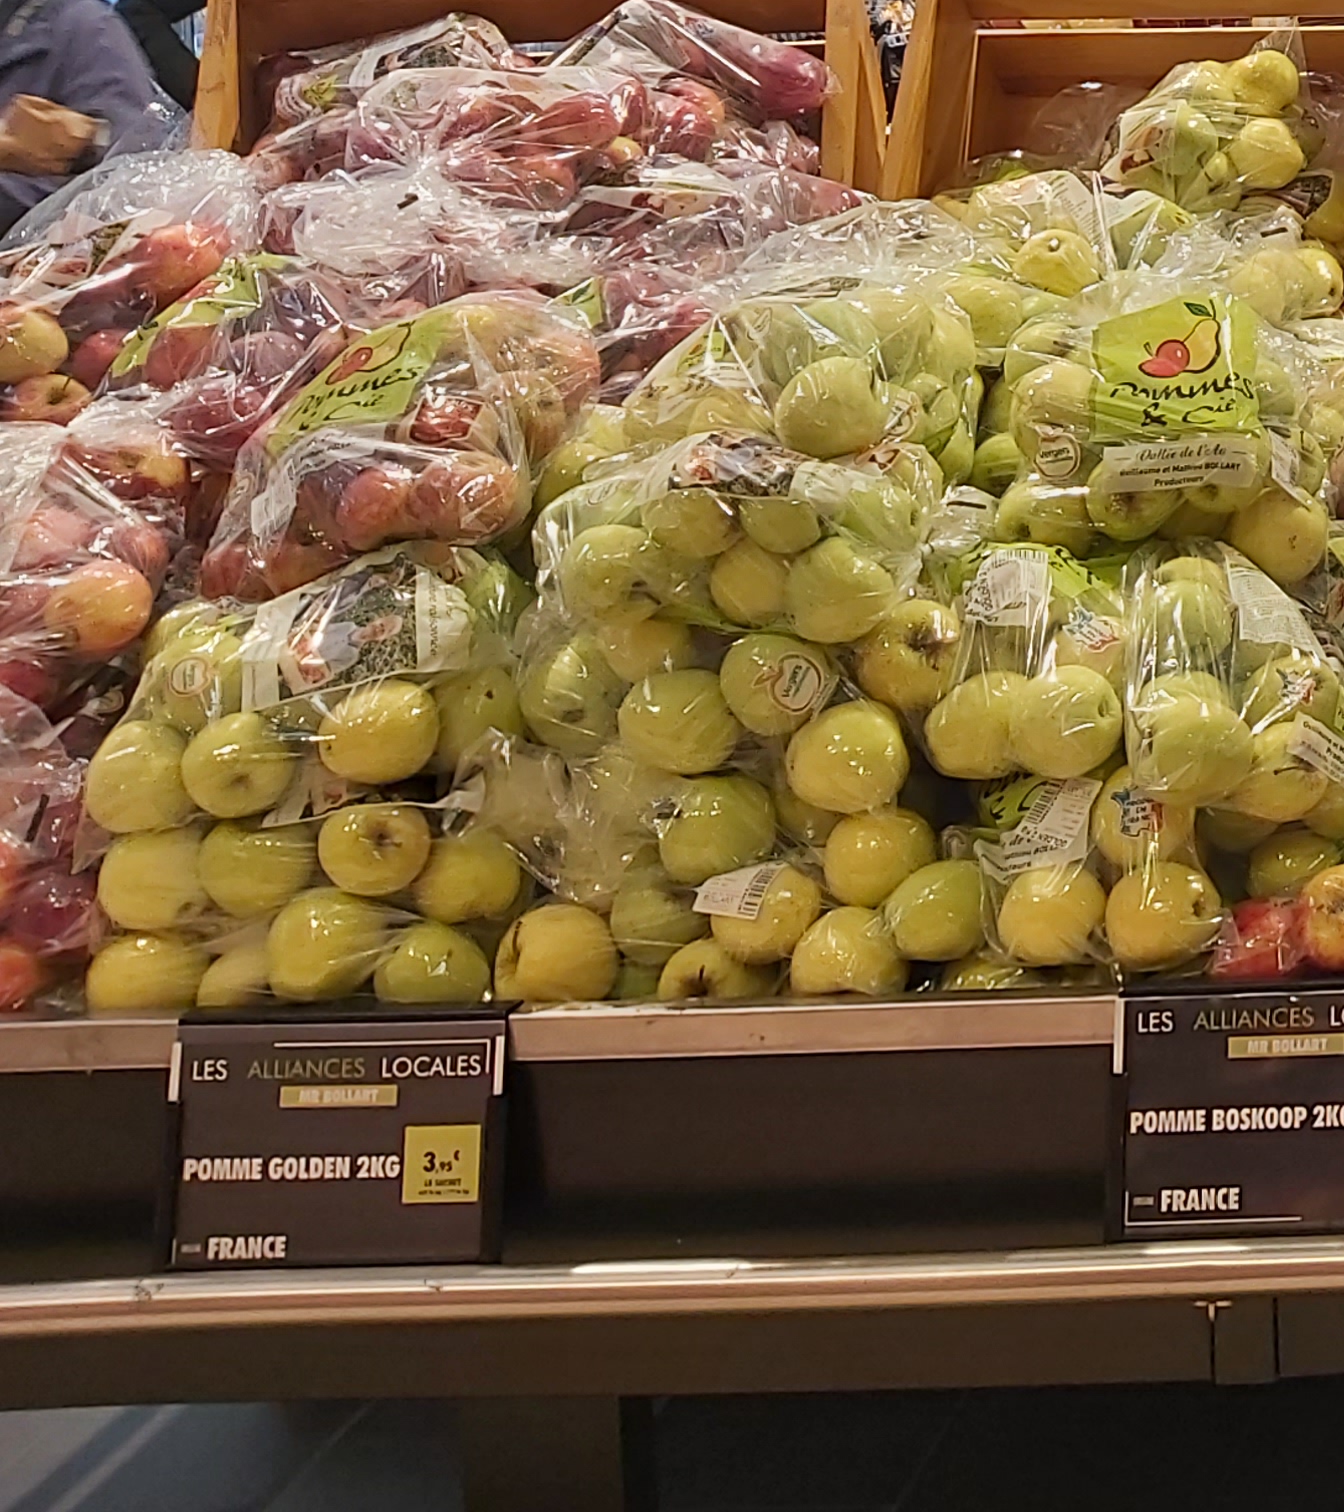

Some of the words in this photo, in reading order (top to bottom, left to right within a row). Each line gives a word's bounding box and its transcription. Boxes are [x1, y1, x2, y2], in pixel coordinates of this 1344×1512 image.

[1137, 1010, 1174, 1033] LES
[1193, 1007, 1315, 1031] ALLIANCES
[1271, 1037, 1329, 1053] BOLLART
[192, 1058, 229, 1081] LES
[247, 1056, 366, 1080] ALLIANCES
[381, 1054, 481, 1078] LOCALES
[1129, 1108, 1207, 1134] POMME
[1211, 1106, 1308, 1132] BOSKOOP
[183, 1157, 263, 1182] POMME
[267, 1155, 351, 1180] GOLDEN
[355, 1154, 401, 1178] 2KG
[1160, 1187, 1241, 1212] FRANCE
[206, 1234, 288, 1260] FRANCE
